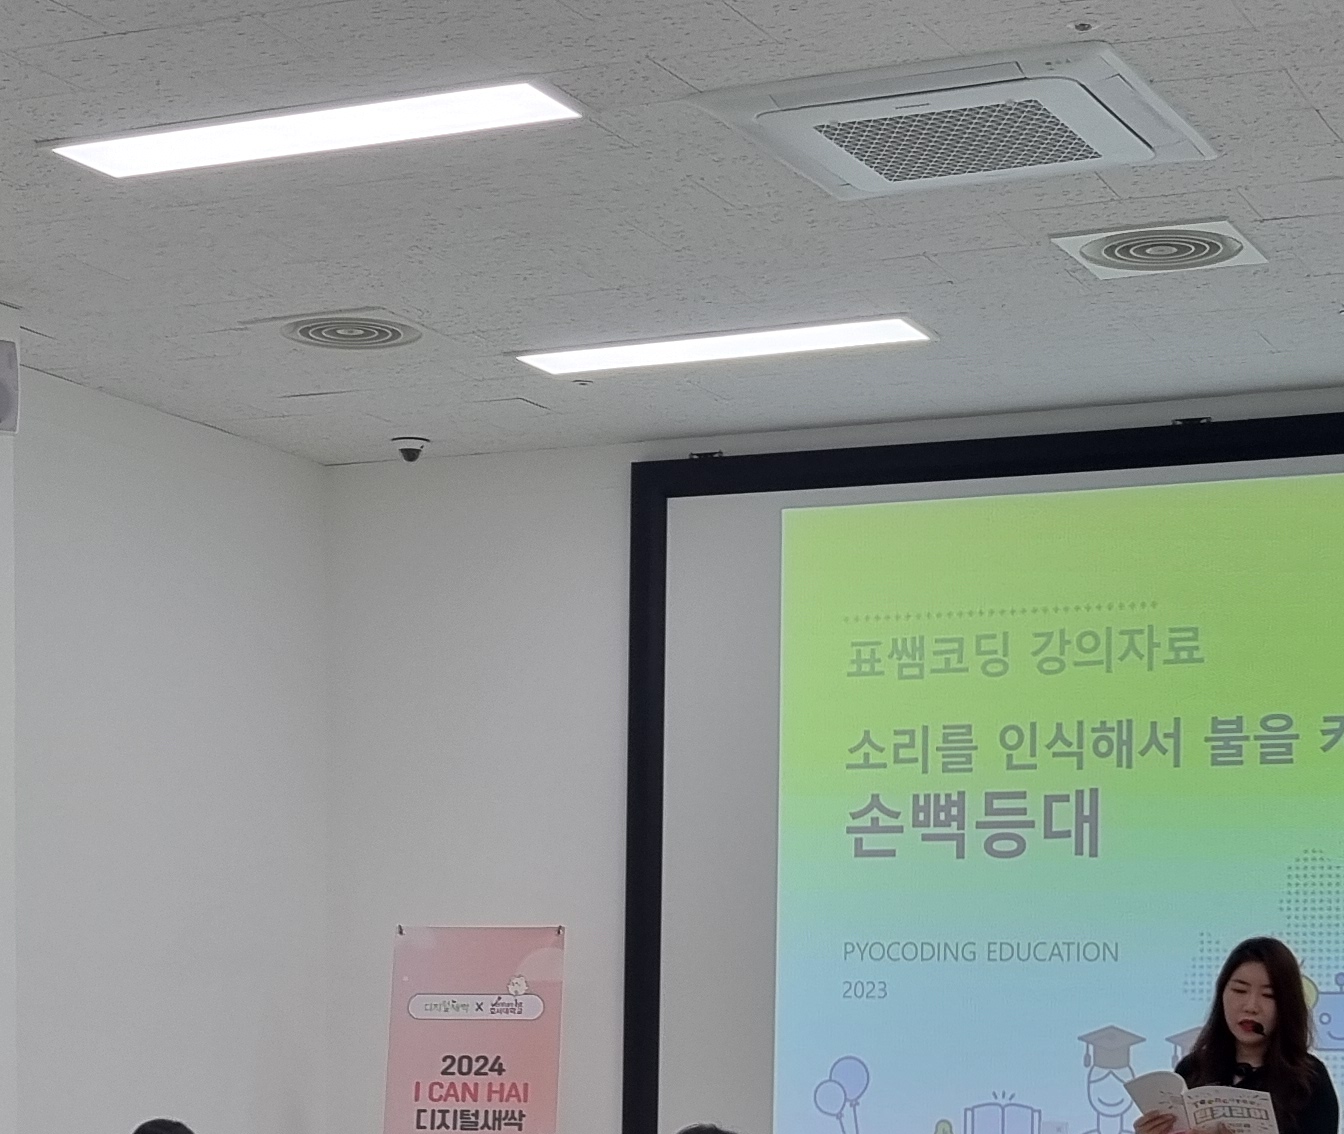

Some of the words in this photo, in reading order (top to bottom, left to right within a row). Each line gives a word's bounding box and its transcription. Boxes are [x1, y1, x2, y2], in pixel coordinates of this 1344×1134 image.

[846, 631, 1010, 681] 표쌤코딩
[1030, 624, 1205, 676] 강의자료
[845, 724, 979, 774] 소리를
[999, 716, 1182, 771] 인식해서
[1204, 713, 1300, 767] 불을
[845, 787, 1099, 860] 손뼉등대
[843, 941, 977, 962] PYOCODING
[987, 941, 1119, 962] EDUCATION
[842, 980, 888, 999] 2023
[440, 1055, 506, 1076] 2024
[414, 1081, 421, 1102] I
[428, 1081, 479, 1102] CAN
[486, 1082, 529, 1103] HAI
[415, 1109, 527, 1132] 디지털새싹
